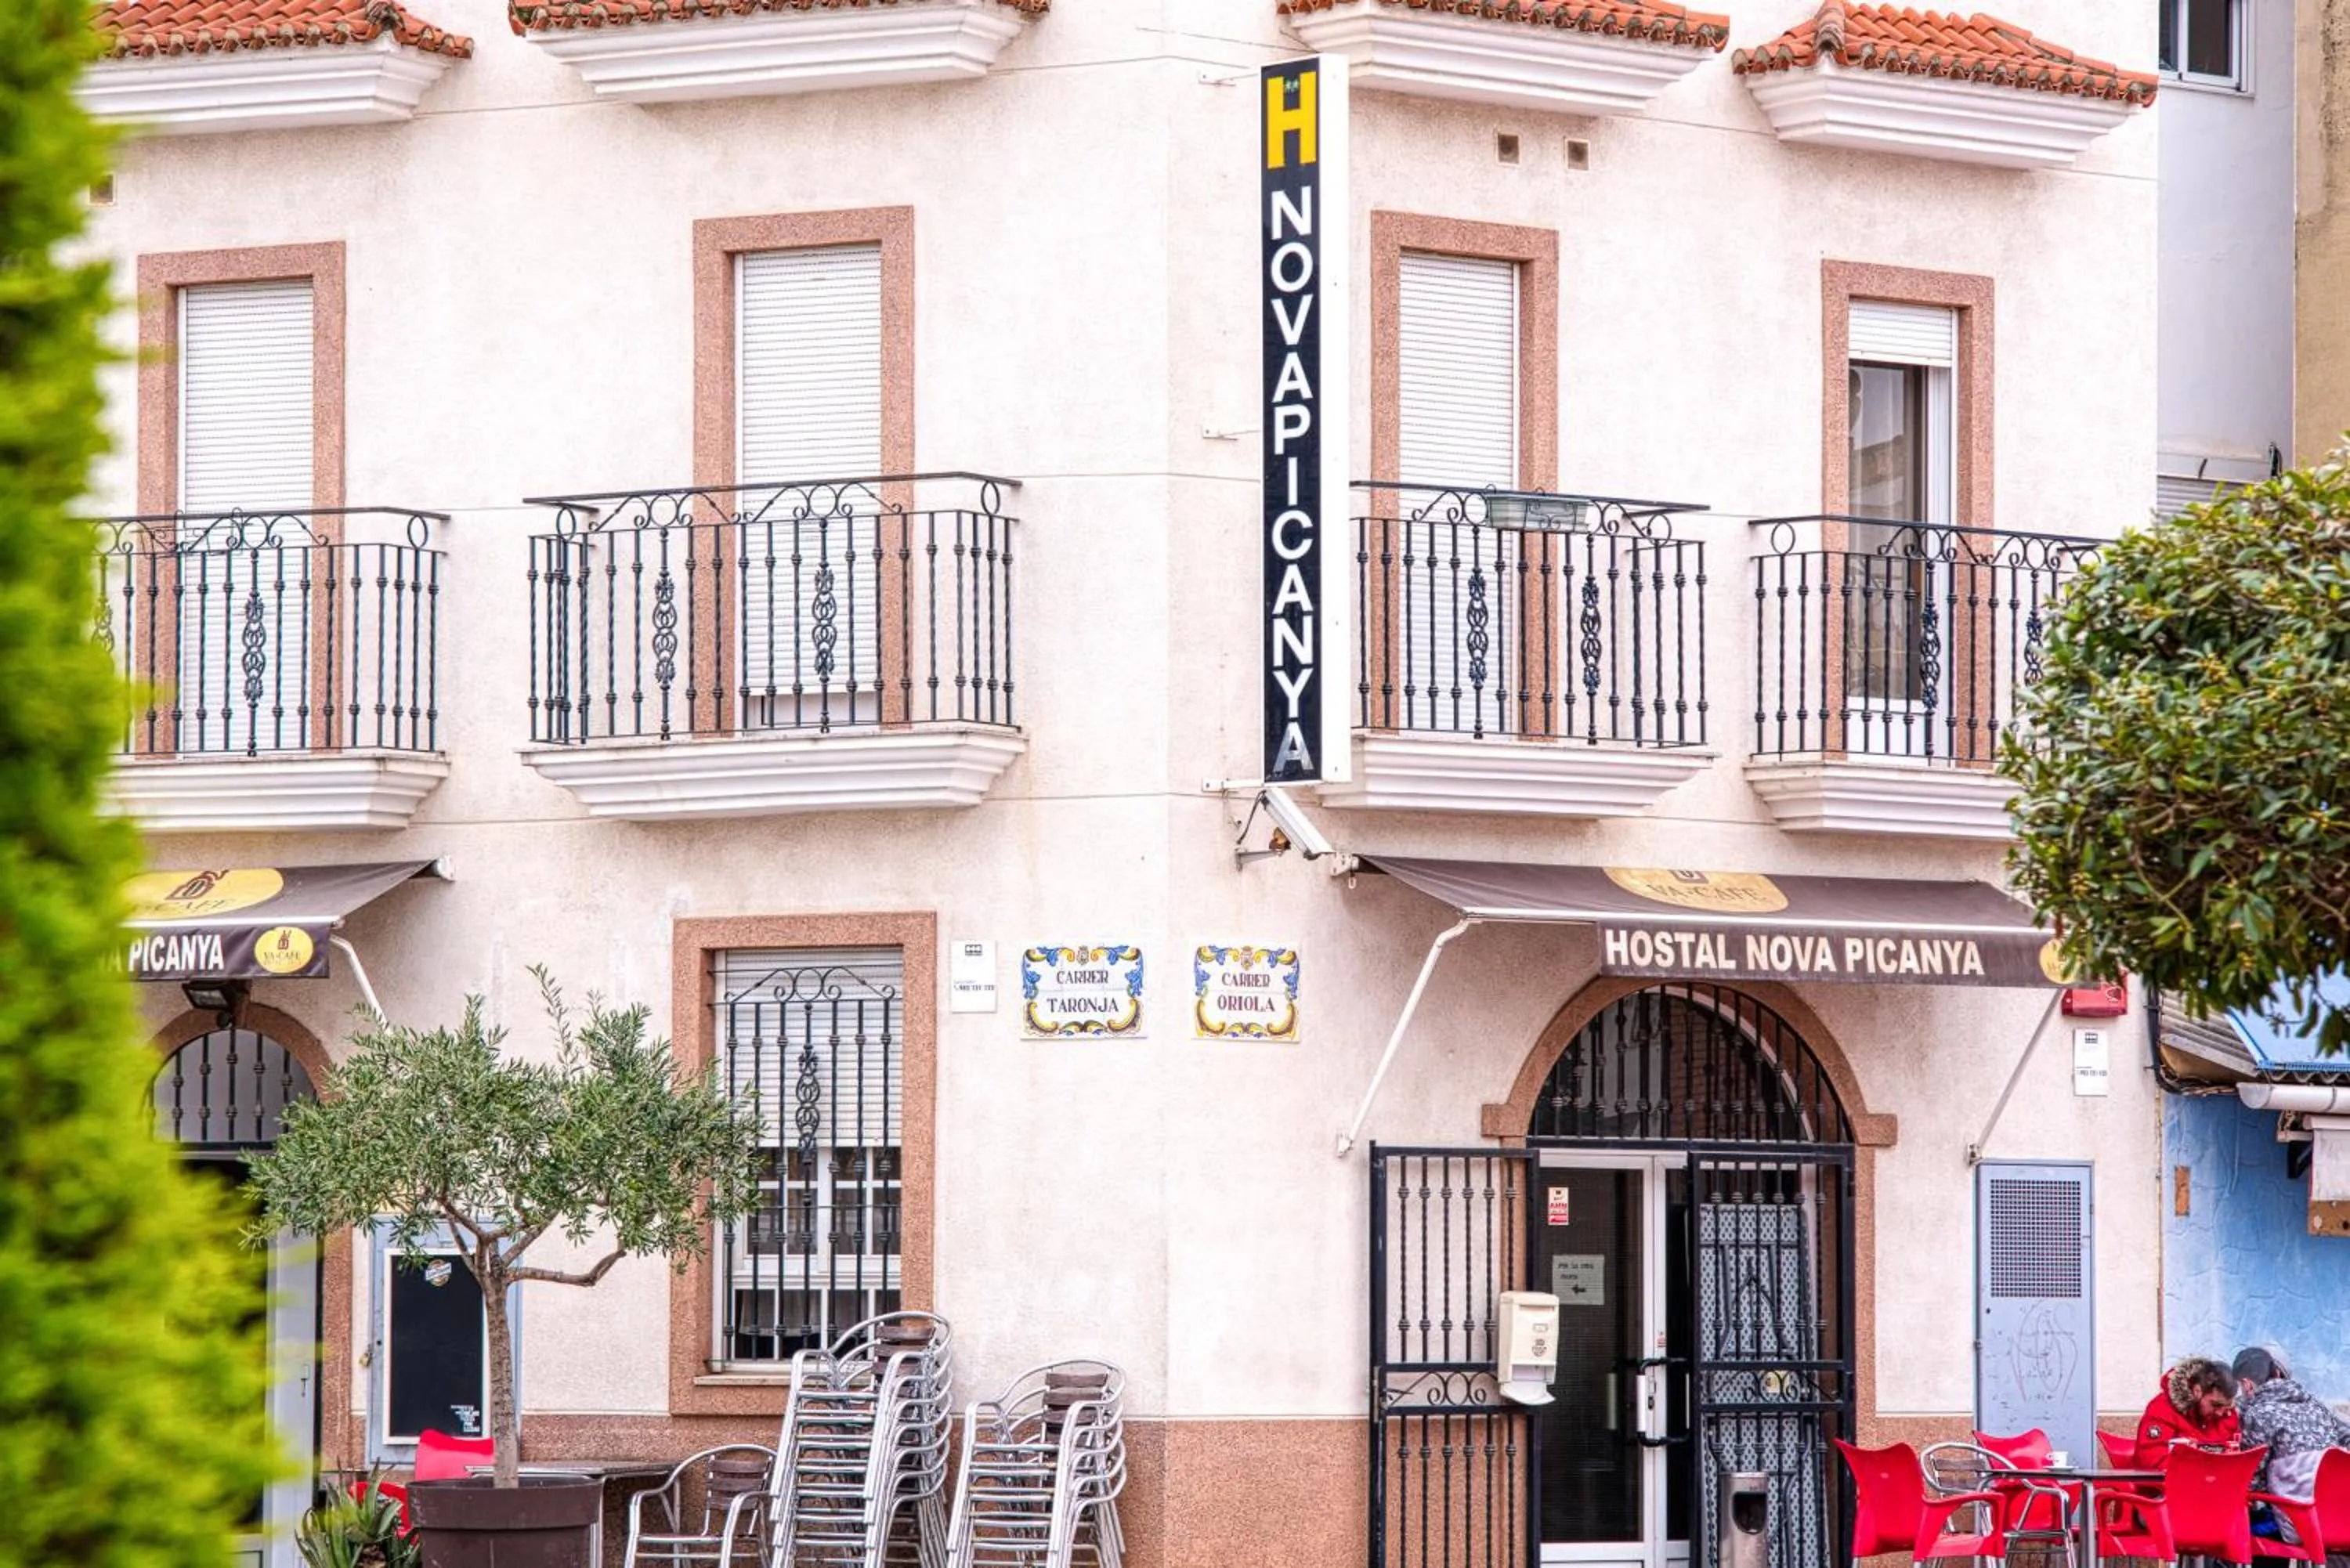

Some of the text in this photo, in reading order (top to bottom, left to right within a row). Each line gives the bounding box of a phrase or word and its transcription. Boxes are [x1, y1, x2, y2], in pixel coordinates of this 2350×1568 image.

[1267, 71, 1317, 169] H
[128, 934, 224, 972] PICANYA
[1606, 929, 1985, 975] HOSTAL NOVA PICANYA
[1056, 970, 1109, 984] CARRER
[1221, 972, 1271, 987] CARRER
[1046, 997, 1119, 1013] TARONJA
[1217, 995, 1275, 1012] ORIOLA
